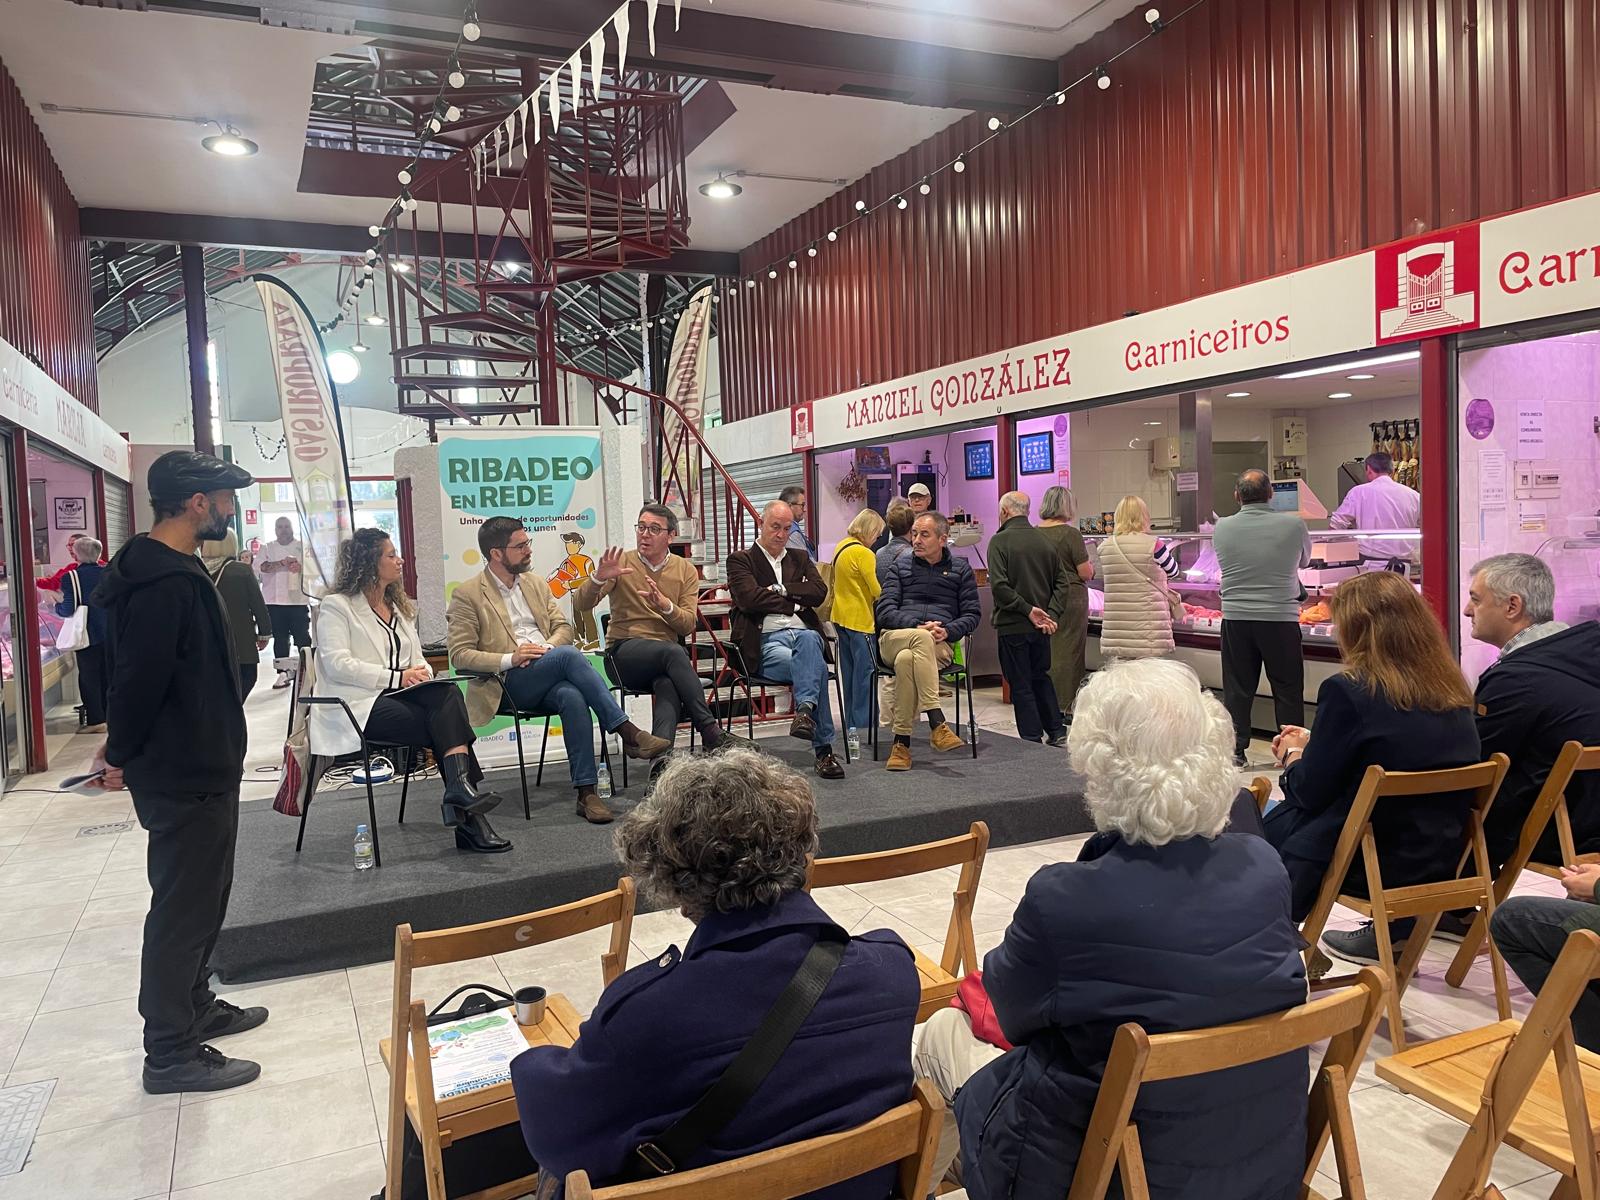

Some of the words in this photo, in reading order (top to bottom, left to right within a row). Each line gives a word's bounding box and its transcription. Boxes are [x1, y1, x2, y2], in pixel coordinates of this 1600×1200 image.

[1125, 315, 1290, 371] Carniceiros
[846, 385, 924, 429] MANUEL
[930, 348, 1071, 417] GONZÁLEZ
[448, 456, 593, 483] RIBADEO
[451, 494, 476, 509] EN
[480, 484, 554, 508] REDE
[460, 517, 483, 525] Unha
[529, 513, 589, 525] oportunidades
